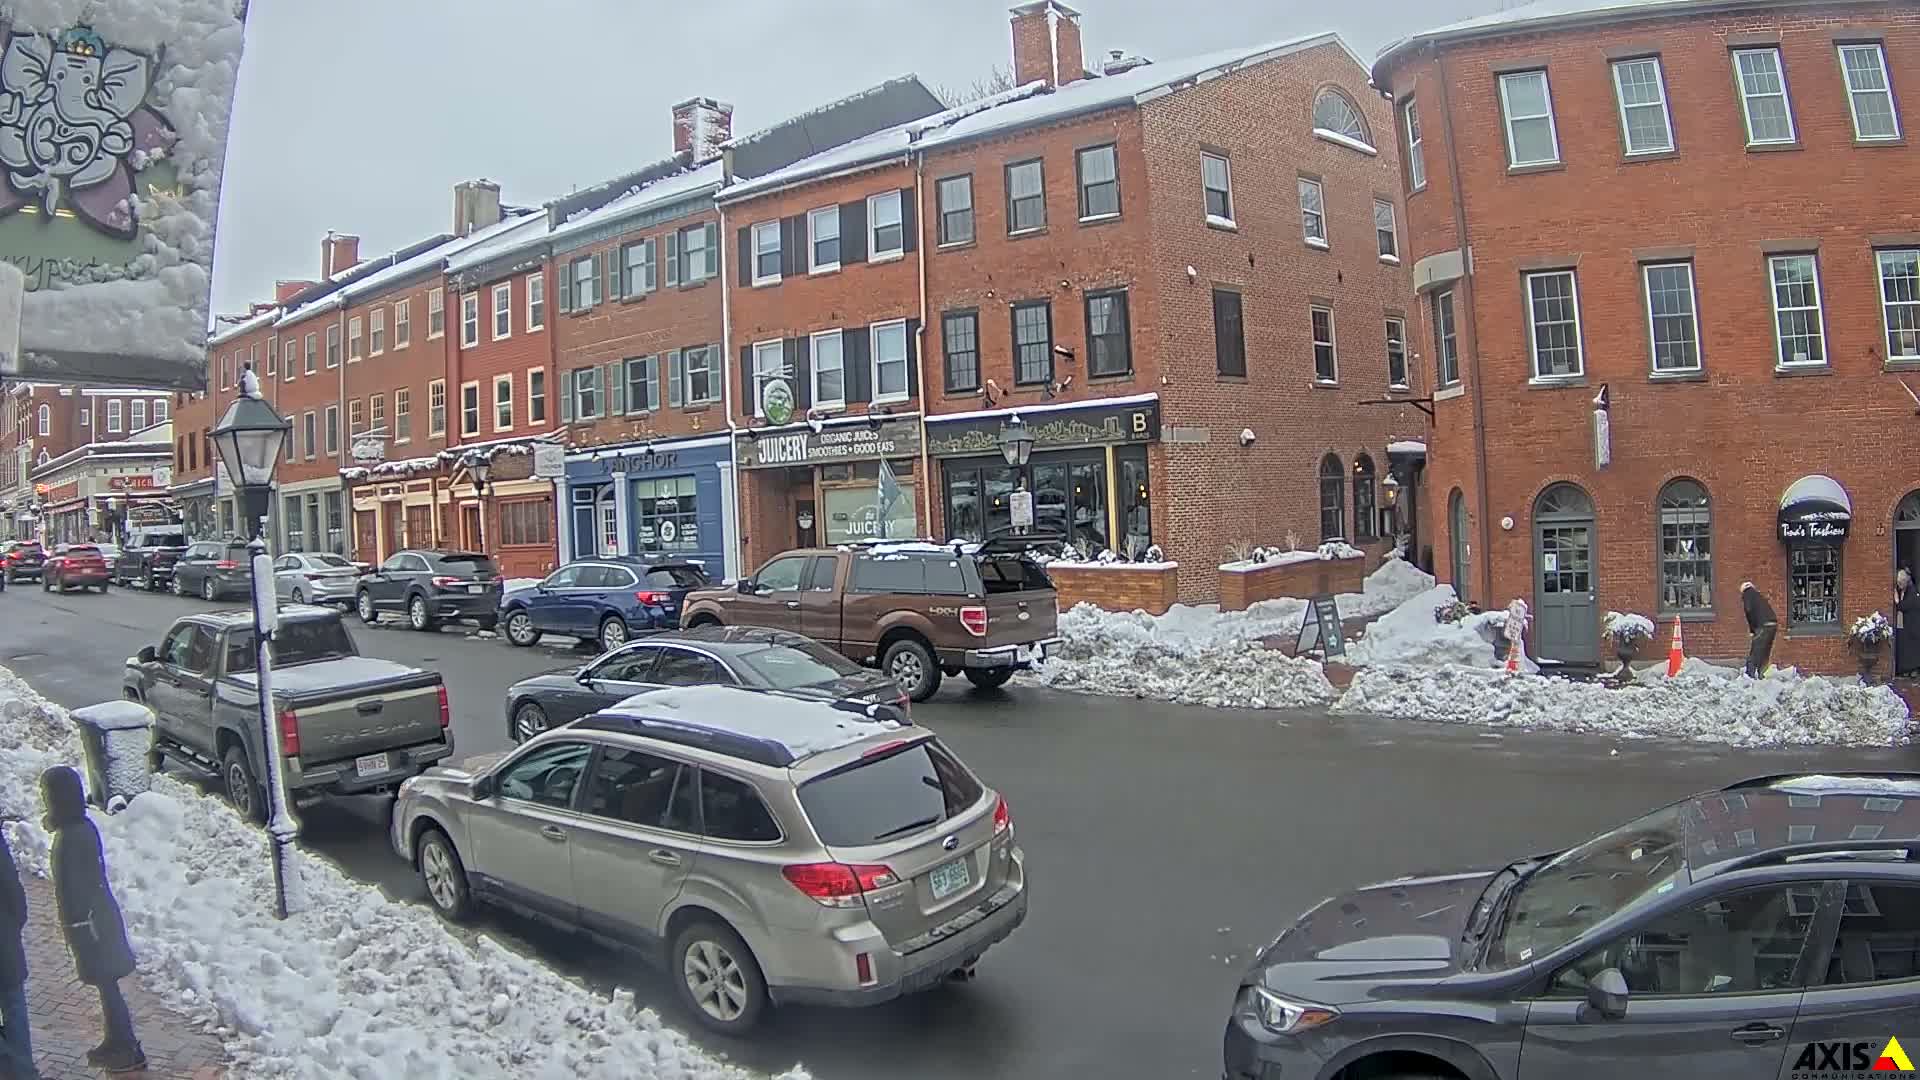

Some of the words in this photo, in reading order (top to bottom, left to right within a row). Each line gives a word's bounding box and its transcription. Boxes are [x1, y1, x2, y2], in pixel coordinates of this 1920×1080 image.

[820, 431, 852, 444] ORGANIC
[853, 429, 879, 442] JUICES
[757, 433, 808, 464] JUICERY
[807, 445, 847, 458] SMOOTHIES
[853, 442, 876, 454] GOOD
[877, 440, 895, 453] EATS
[1781, 522, 1806, 537] Tina's
[1808, 521, 1845, 538] Fashions
